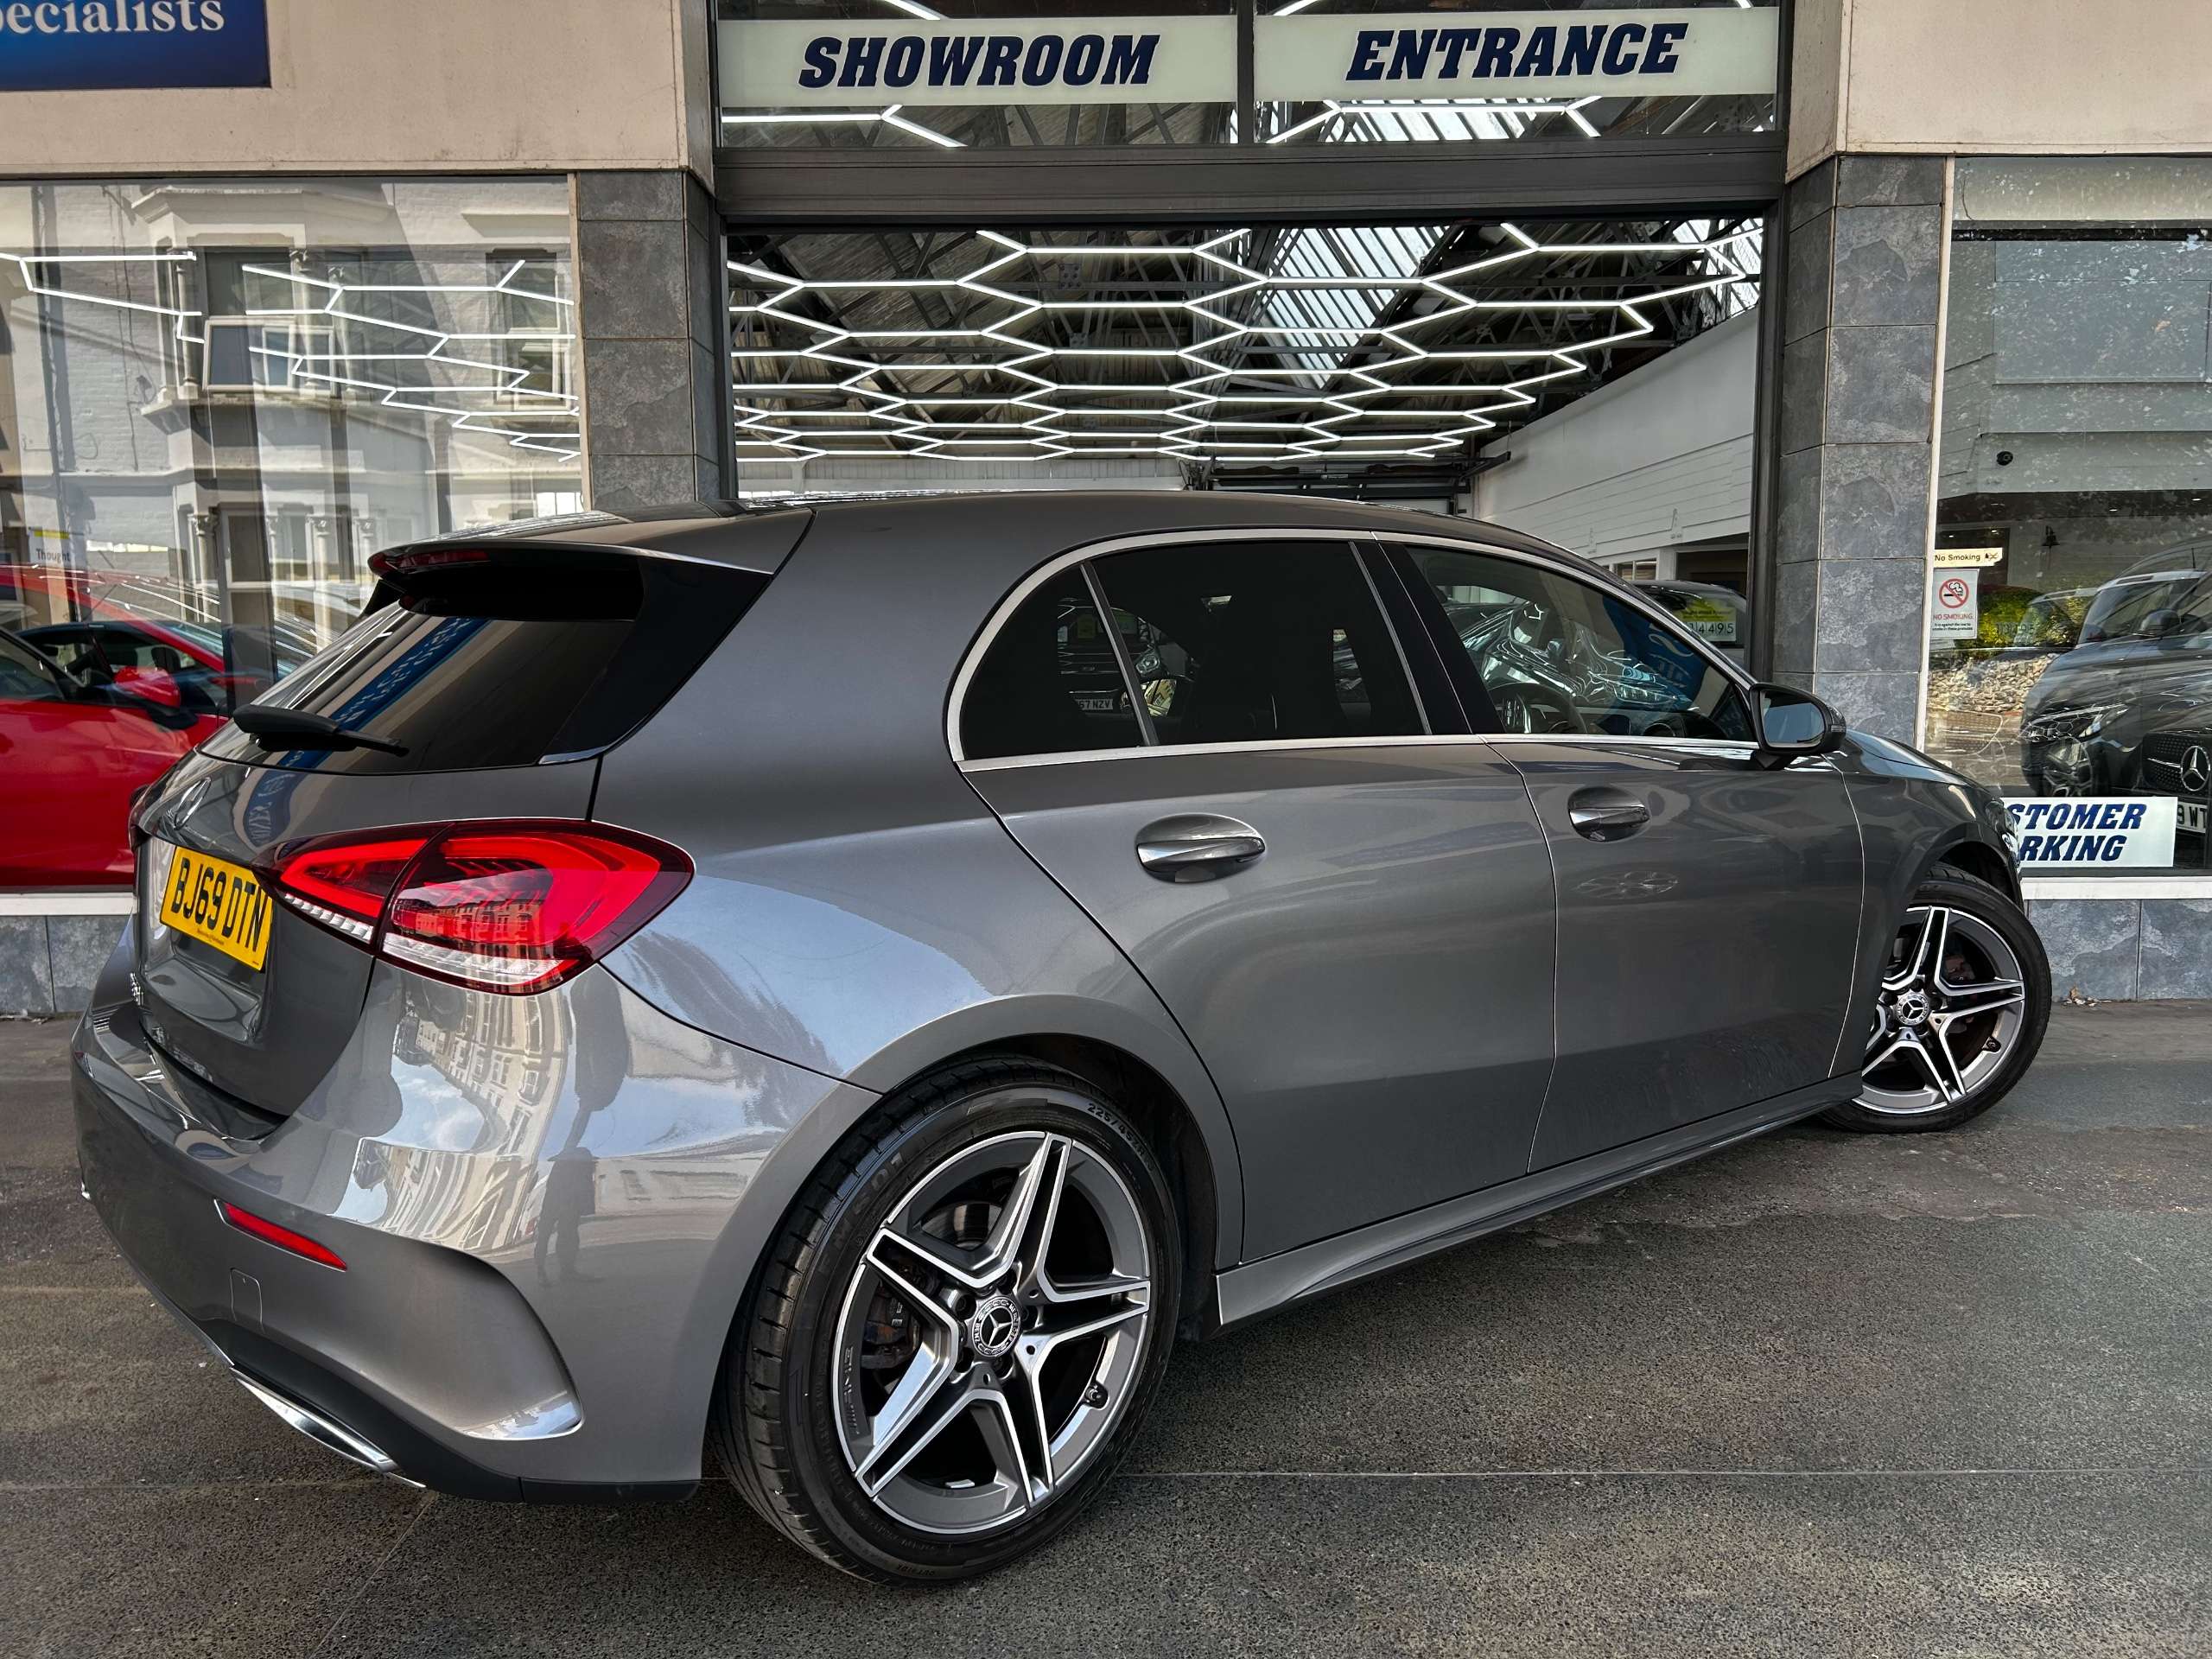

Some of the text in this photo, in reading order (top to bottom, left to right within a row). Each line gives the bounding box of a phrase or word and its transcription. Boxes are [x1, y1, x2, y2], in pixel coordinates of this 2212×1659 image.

[0, 0, 225, 35] ecialists
[798, 35, 1160, 88] SHOWROOM
[1345, 23, 1689, 81] ENTRANCE
[36, 548, 70, 564] Thought
[171, 857, 269, 952] BJ69 DTN
